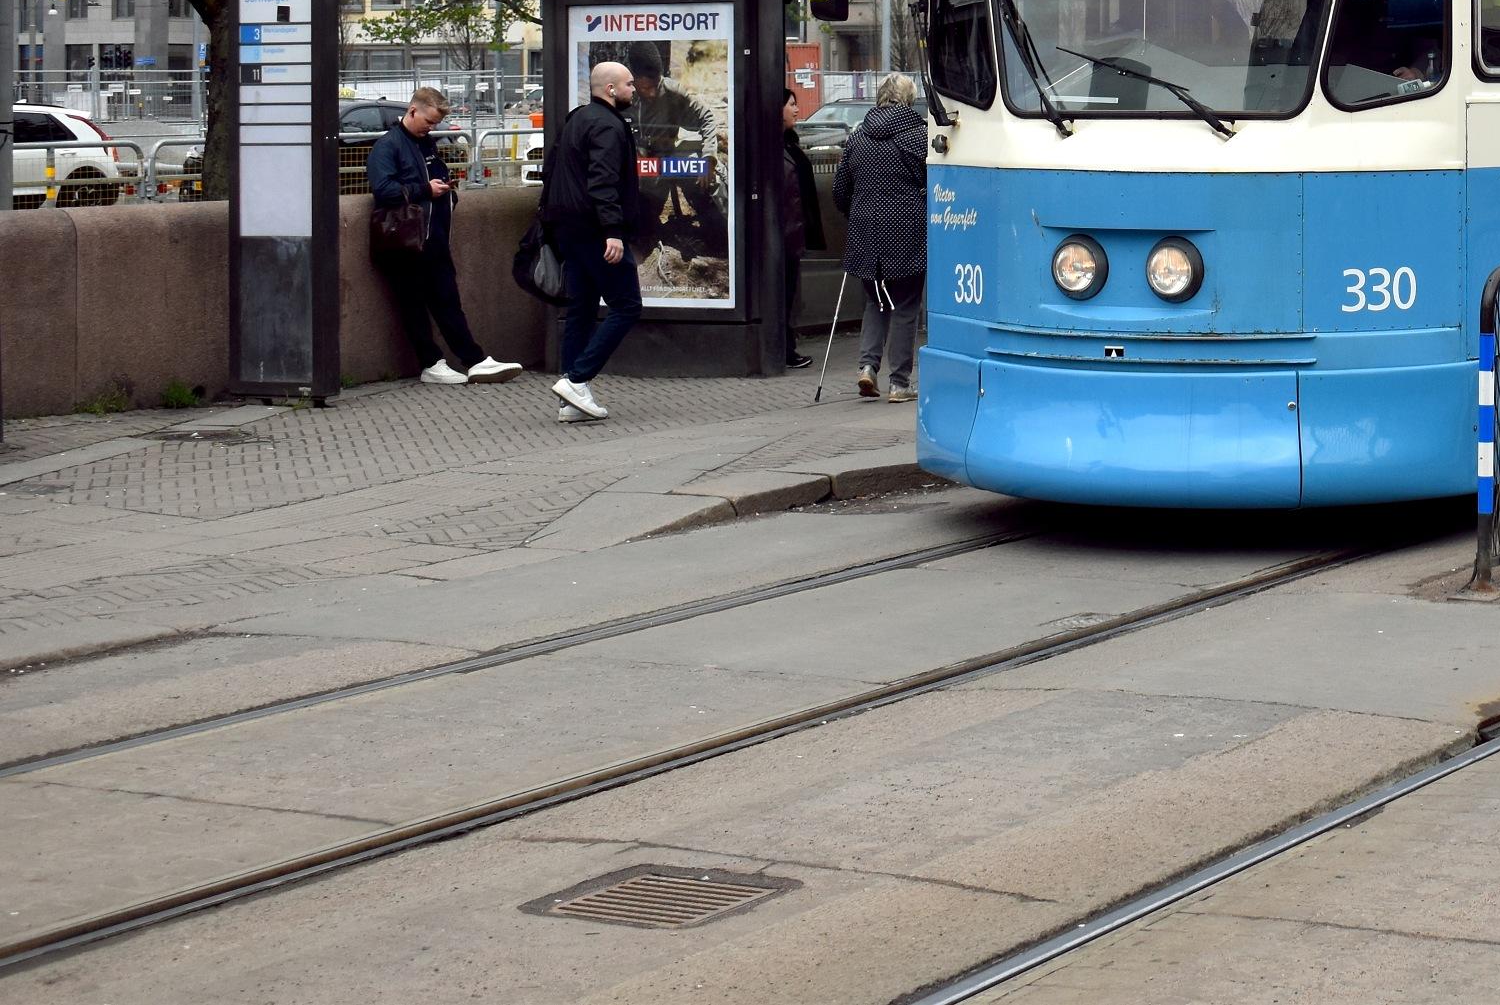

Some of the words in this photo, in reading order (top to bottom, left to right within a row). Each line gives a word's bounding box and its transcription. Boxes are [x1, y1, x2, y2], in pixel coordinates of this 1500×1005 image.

[604, 12, 720, 32] INTERSPORT
[254, 28, 260, 41] 3
[252, 68, 260, 81] 11
[637, 160, 657, 174] EN
[670, 159, 706, 173] LIVET
[933, 182, 956, 203] Victor
[930, 212, 943, 225] von
[943, 205, 978, 232] Gegerfelt
[954, 263, 983, 305] 330
[1341, 266, 1417, 313] 330
